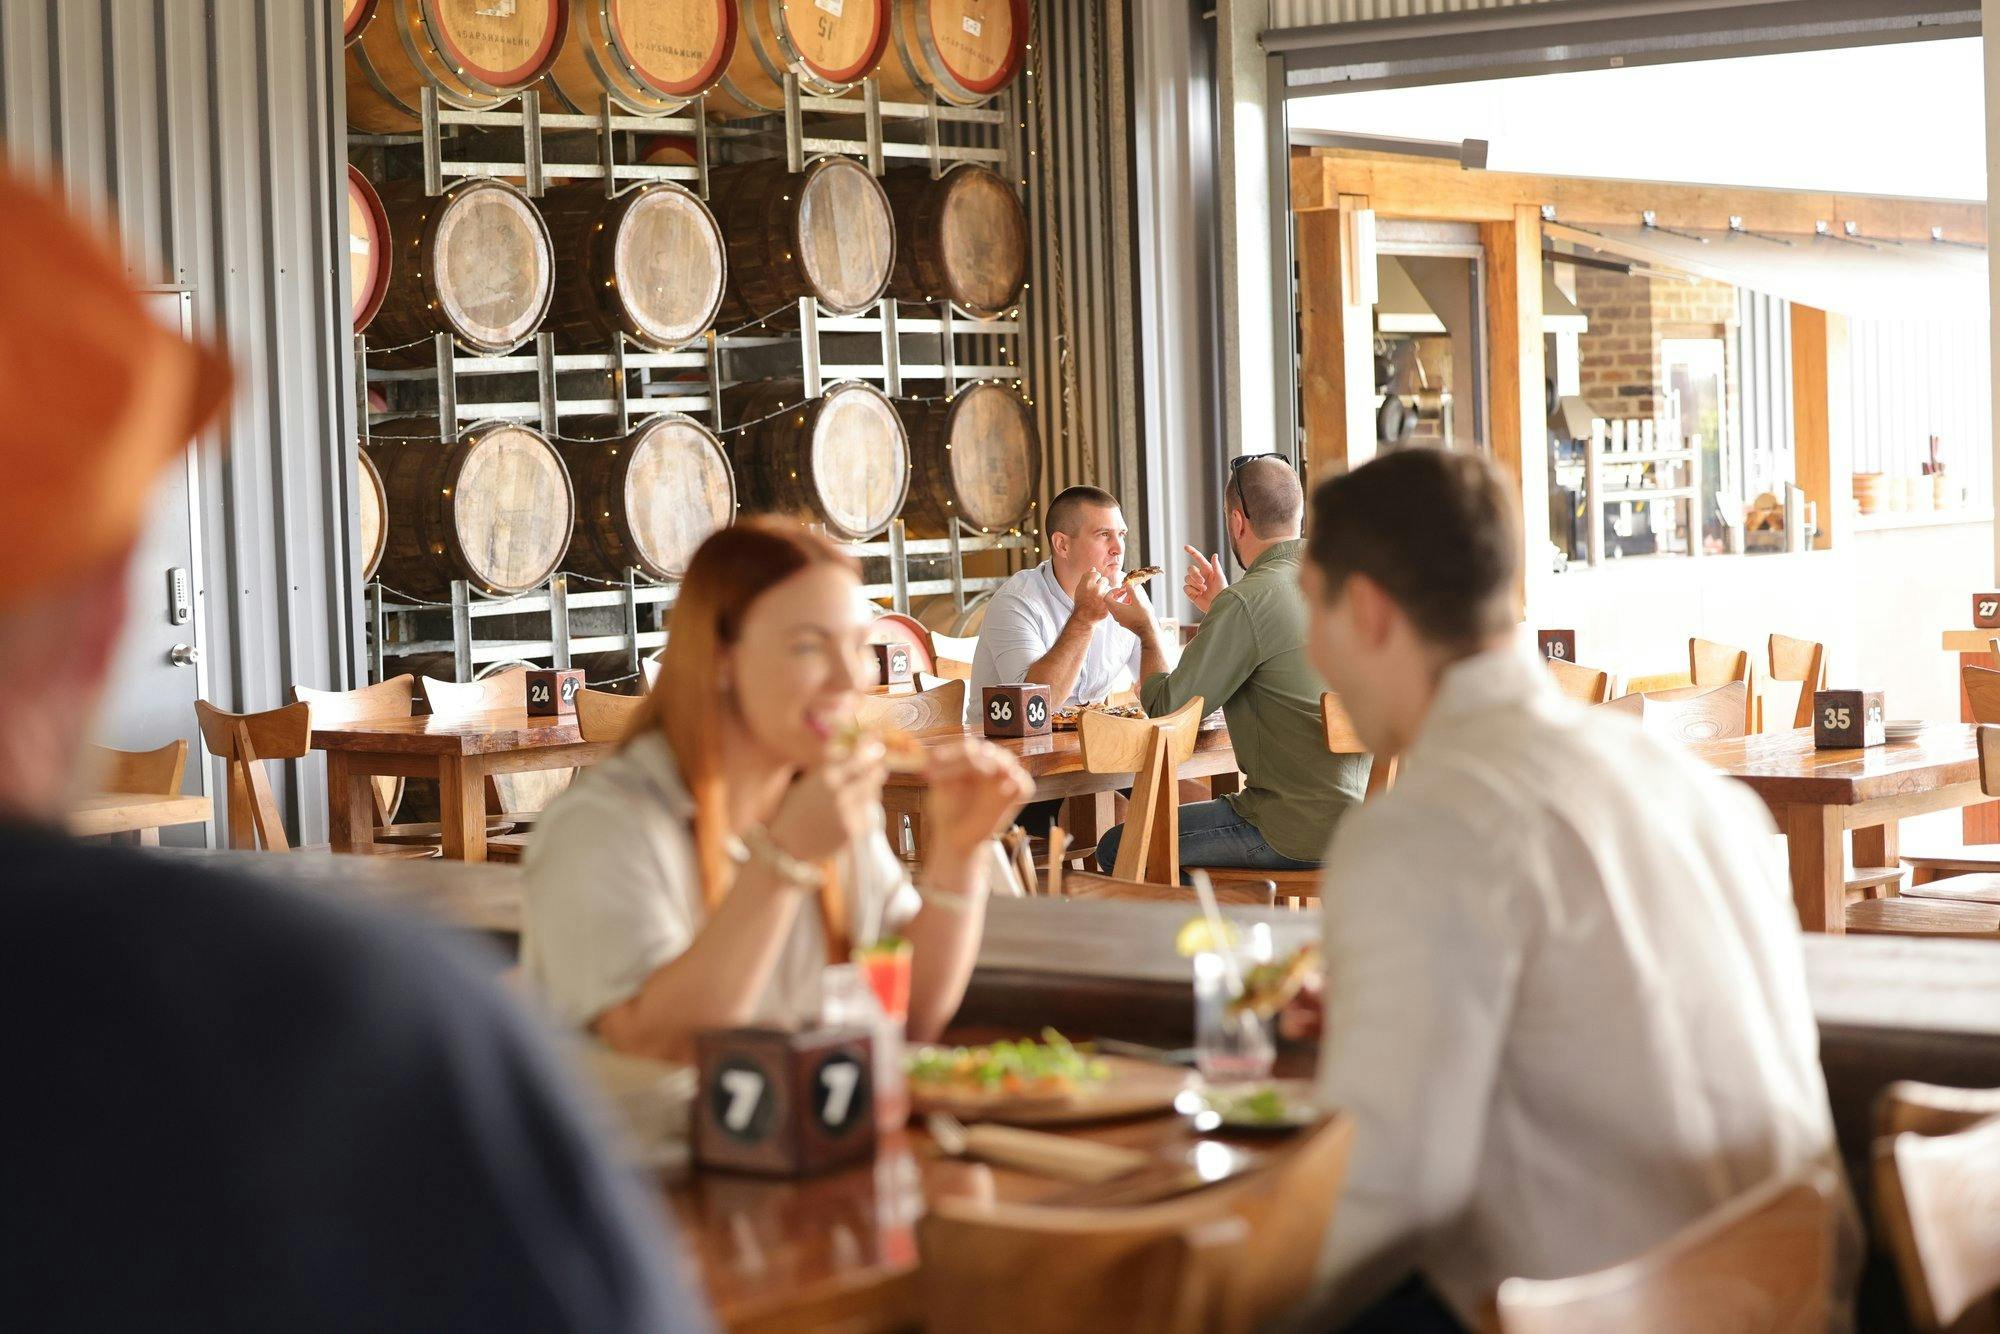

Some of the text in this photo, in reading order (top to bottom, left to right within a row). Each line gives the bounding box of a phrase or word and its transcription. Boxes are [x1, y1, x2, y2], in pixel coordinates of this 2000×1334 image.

[1979, 601, 1999, 617] 27
[1546, 641, 1565, 657] 18
[531, 685, 550, 702] 24
[990, 701, 1012, 720] 36
[1028, 702, 1046, 722] 36
[1823, 708, 1851, 730] 35
[720, 1068, 765, 1131] 7
